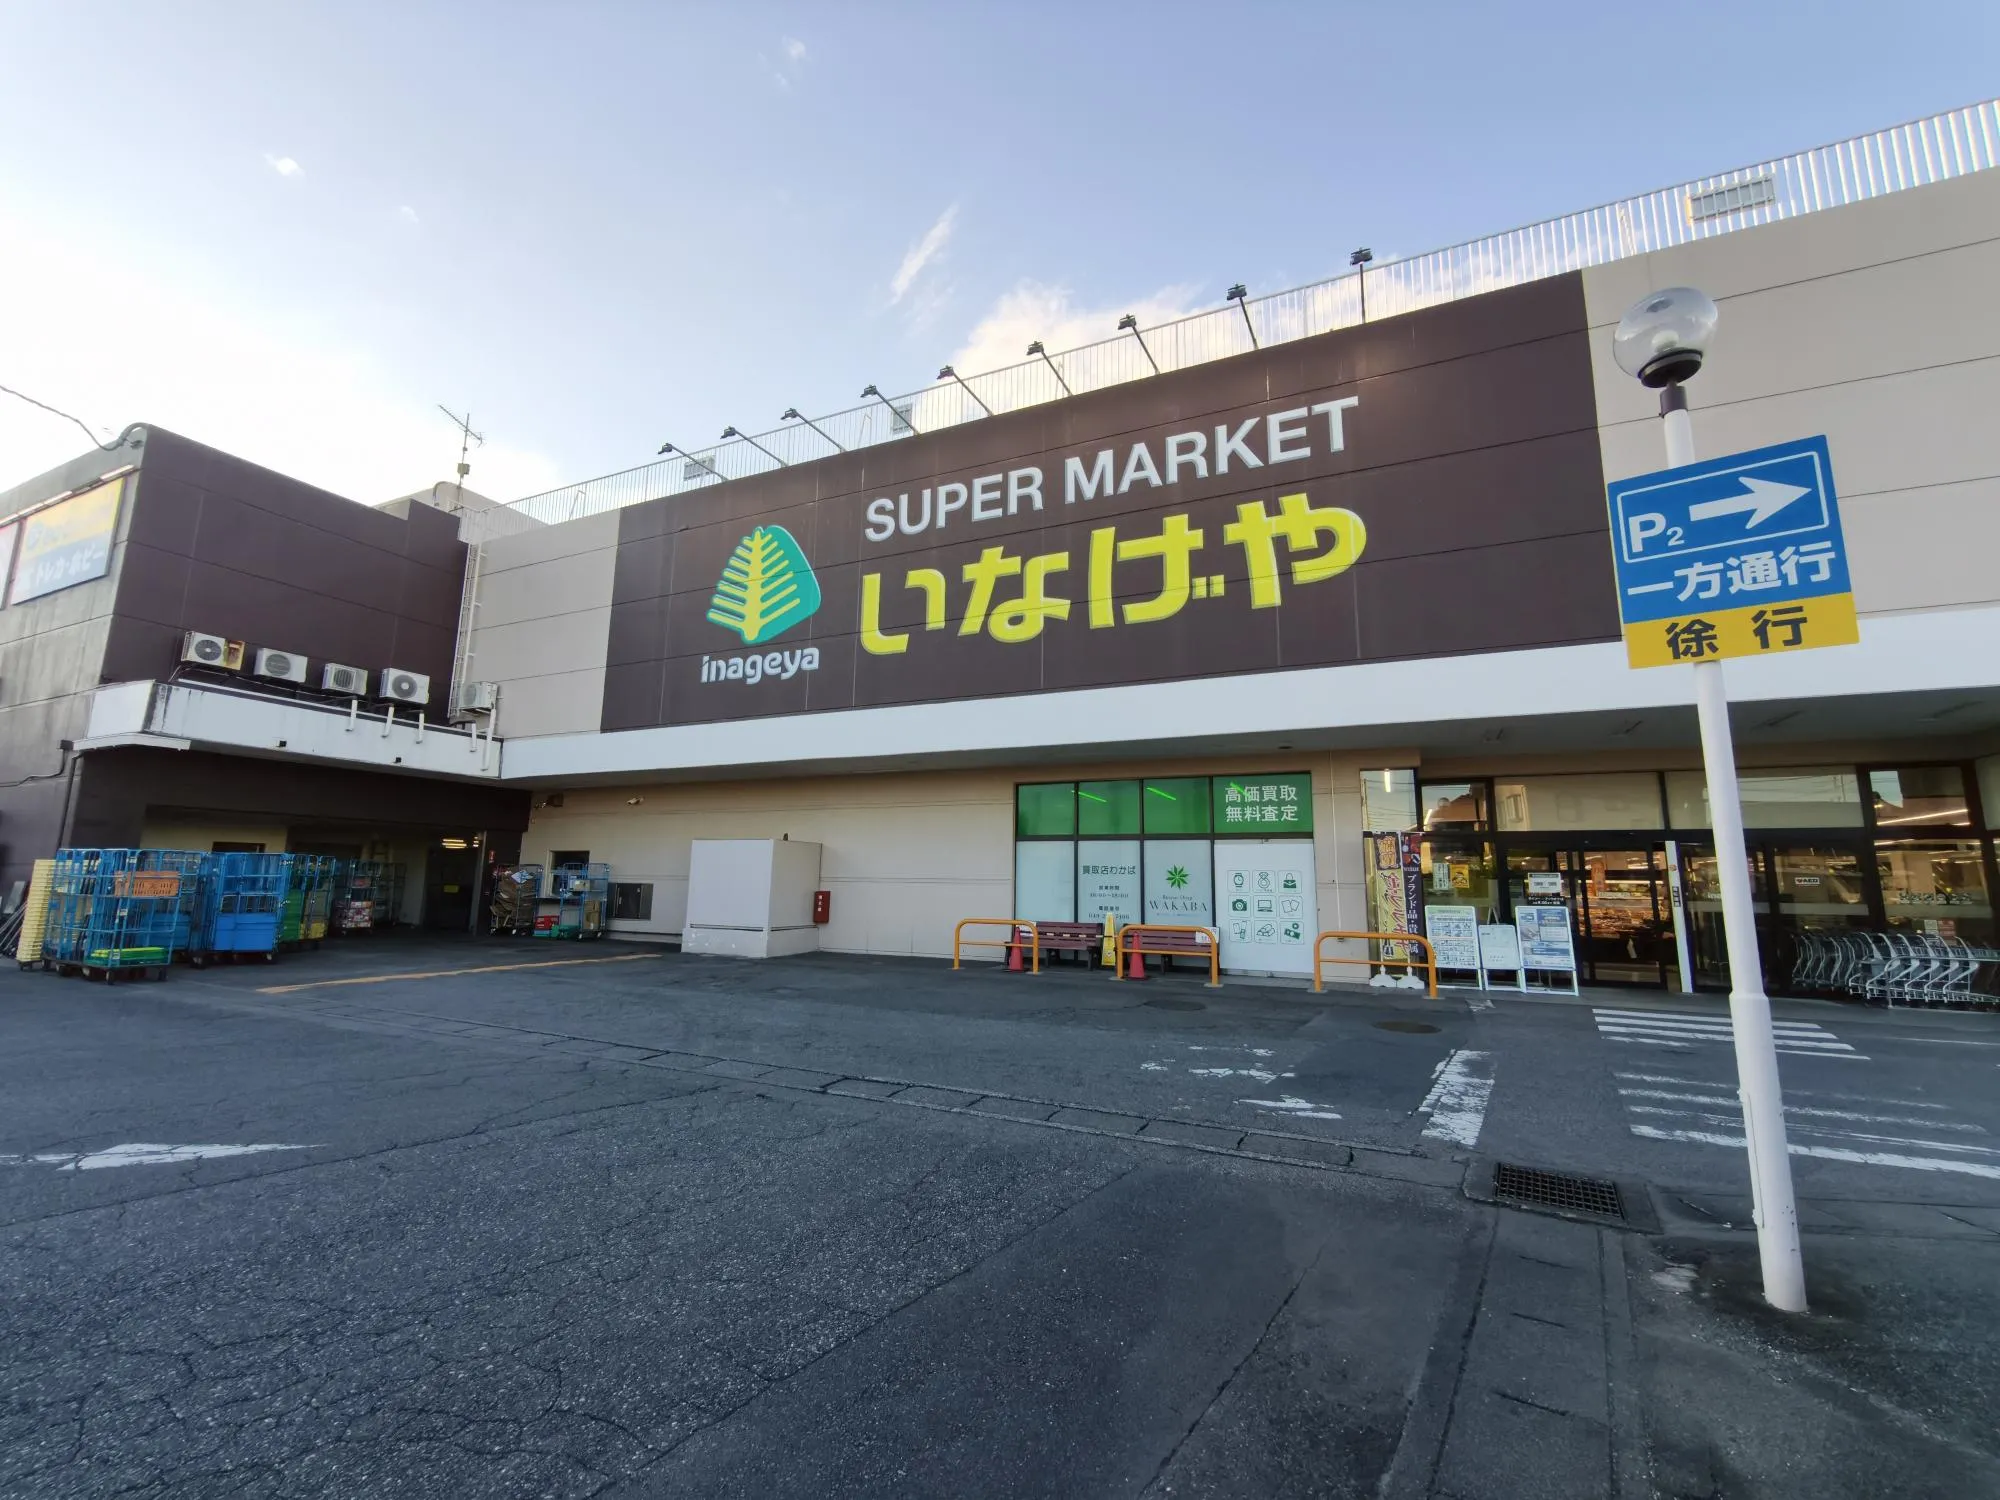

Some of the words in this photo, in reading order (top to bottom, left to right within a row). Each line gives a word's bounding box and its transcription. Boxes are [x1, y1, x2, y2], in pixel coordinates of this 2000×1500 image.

[865, 466, 1044, 542] SUPER
[1065, 396, 1359, 504] MARKET
[860, 493, 1367, 655] いなげや
[1627, 541, 1836, 602] 一方通行
[701, 647, 820, 684] inageya
[1225, 785, 1297, 802] 高価買取
[1226, 804, 1299, 822] 無料査定
[1082, 865, 1136, 875] 買取店わかば
[1149, 900, 1208, 912] WAKABA
